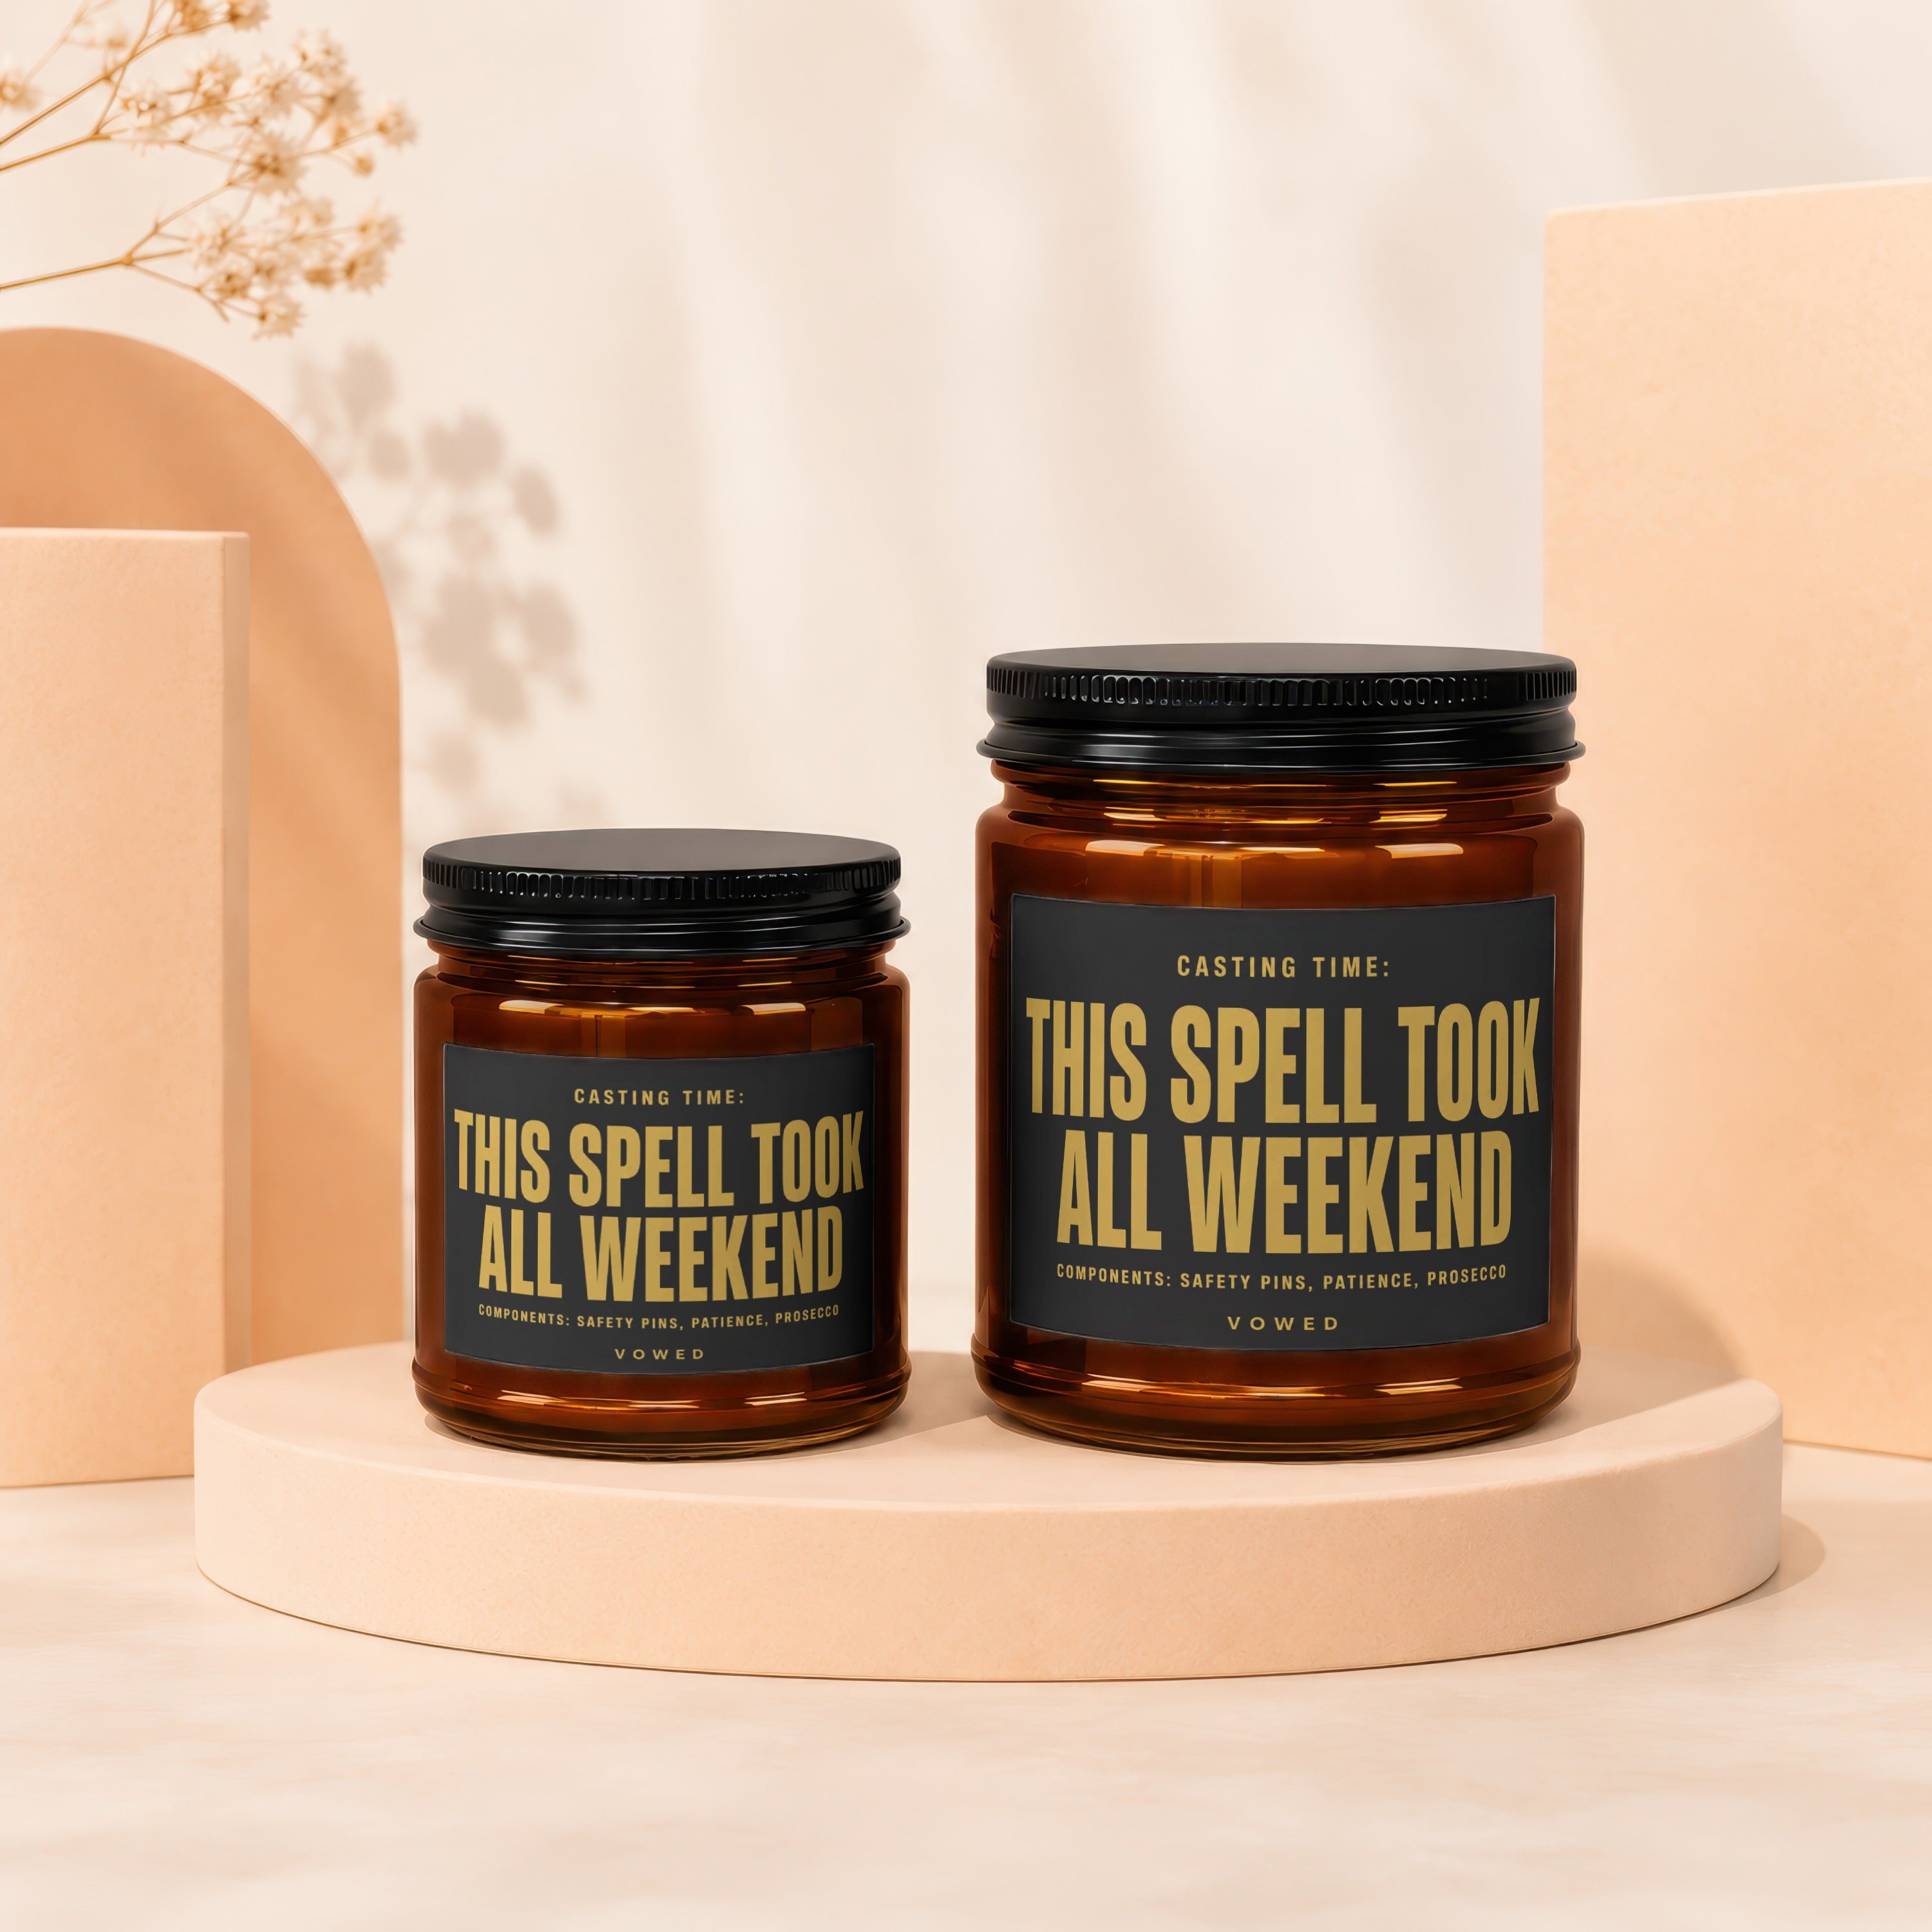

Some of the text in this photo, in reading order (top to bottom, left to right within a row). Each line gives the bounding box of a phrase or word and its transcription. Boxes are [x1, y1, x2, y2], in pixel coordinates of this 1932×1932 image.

[1177, 954, 1389, 978] CASTING TIME:
[1026, 997, 1540, 1124] THIS SPELL TOOK
[574, 1088, 743, 1106] CASTING TIME:
[454, 1108, 864, 1208] THIS SPELL TOOK
[1057, 1129, 1512, 1254] ALL WEEKEND
[478, 1204, 843, 1302] ALL WEEKEND
[1057, 1263, 1506, 1293] COMPONENTS: SAFETY PINS, PATIENCE, PROSECCO
[478, 1303, 839, 1331] COMPONENTS: SAFETY PINS, PATIENCE, PROSECCO
[1227, 1316, 1338, 1331] VOWED
[614, 1349, 704, 1360] VOWED
